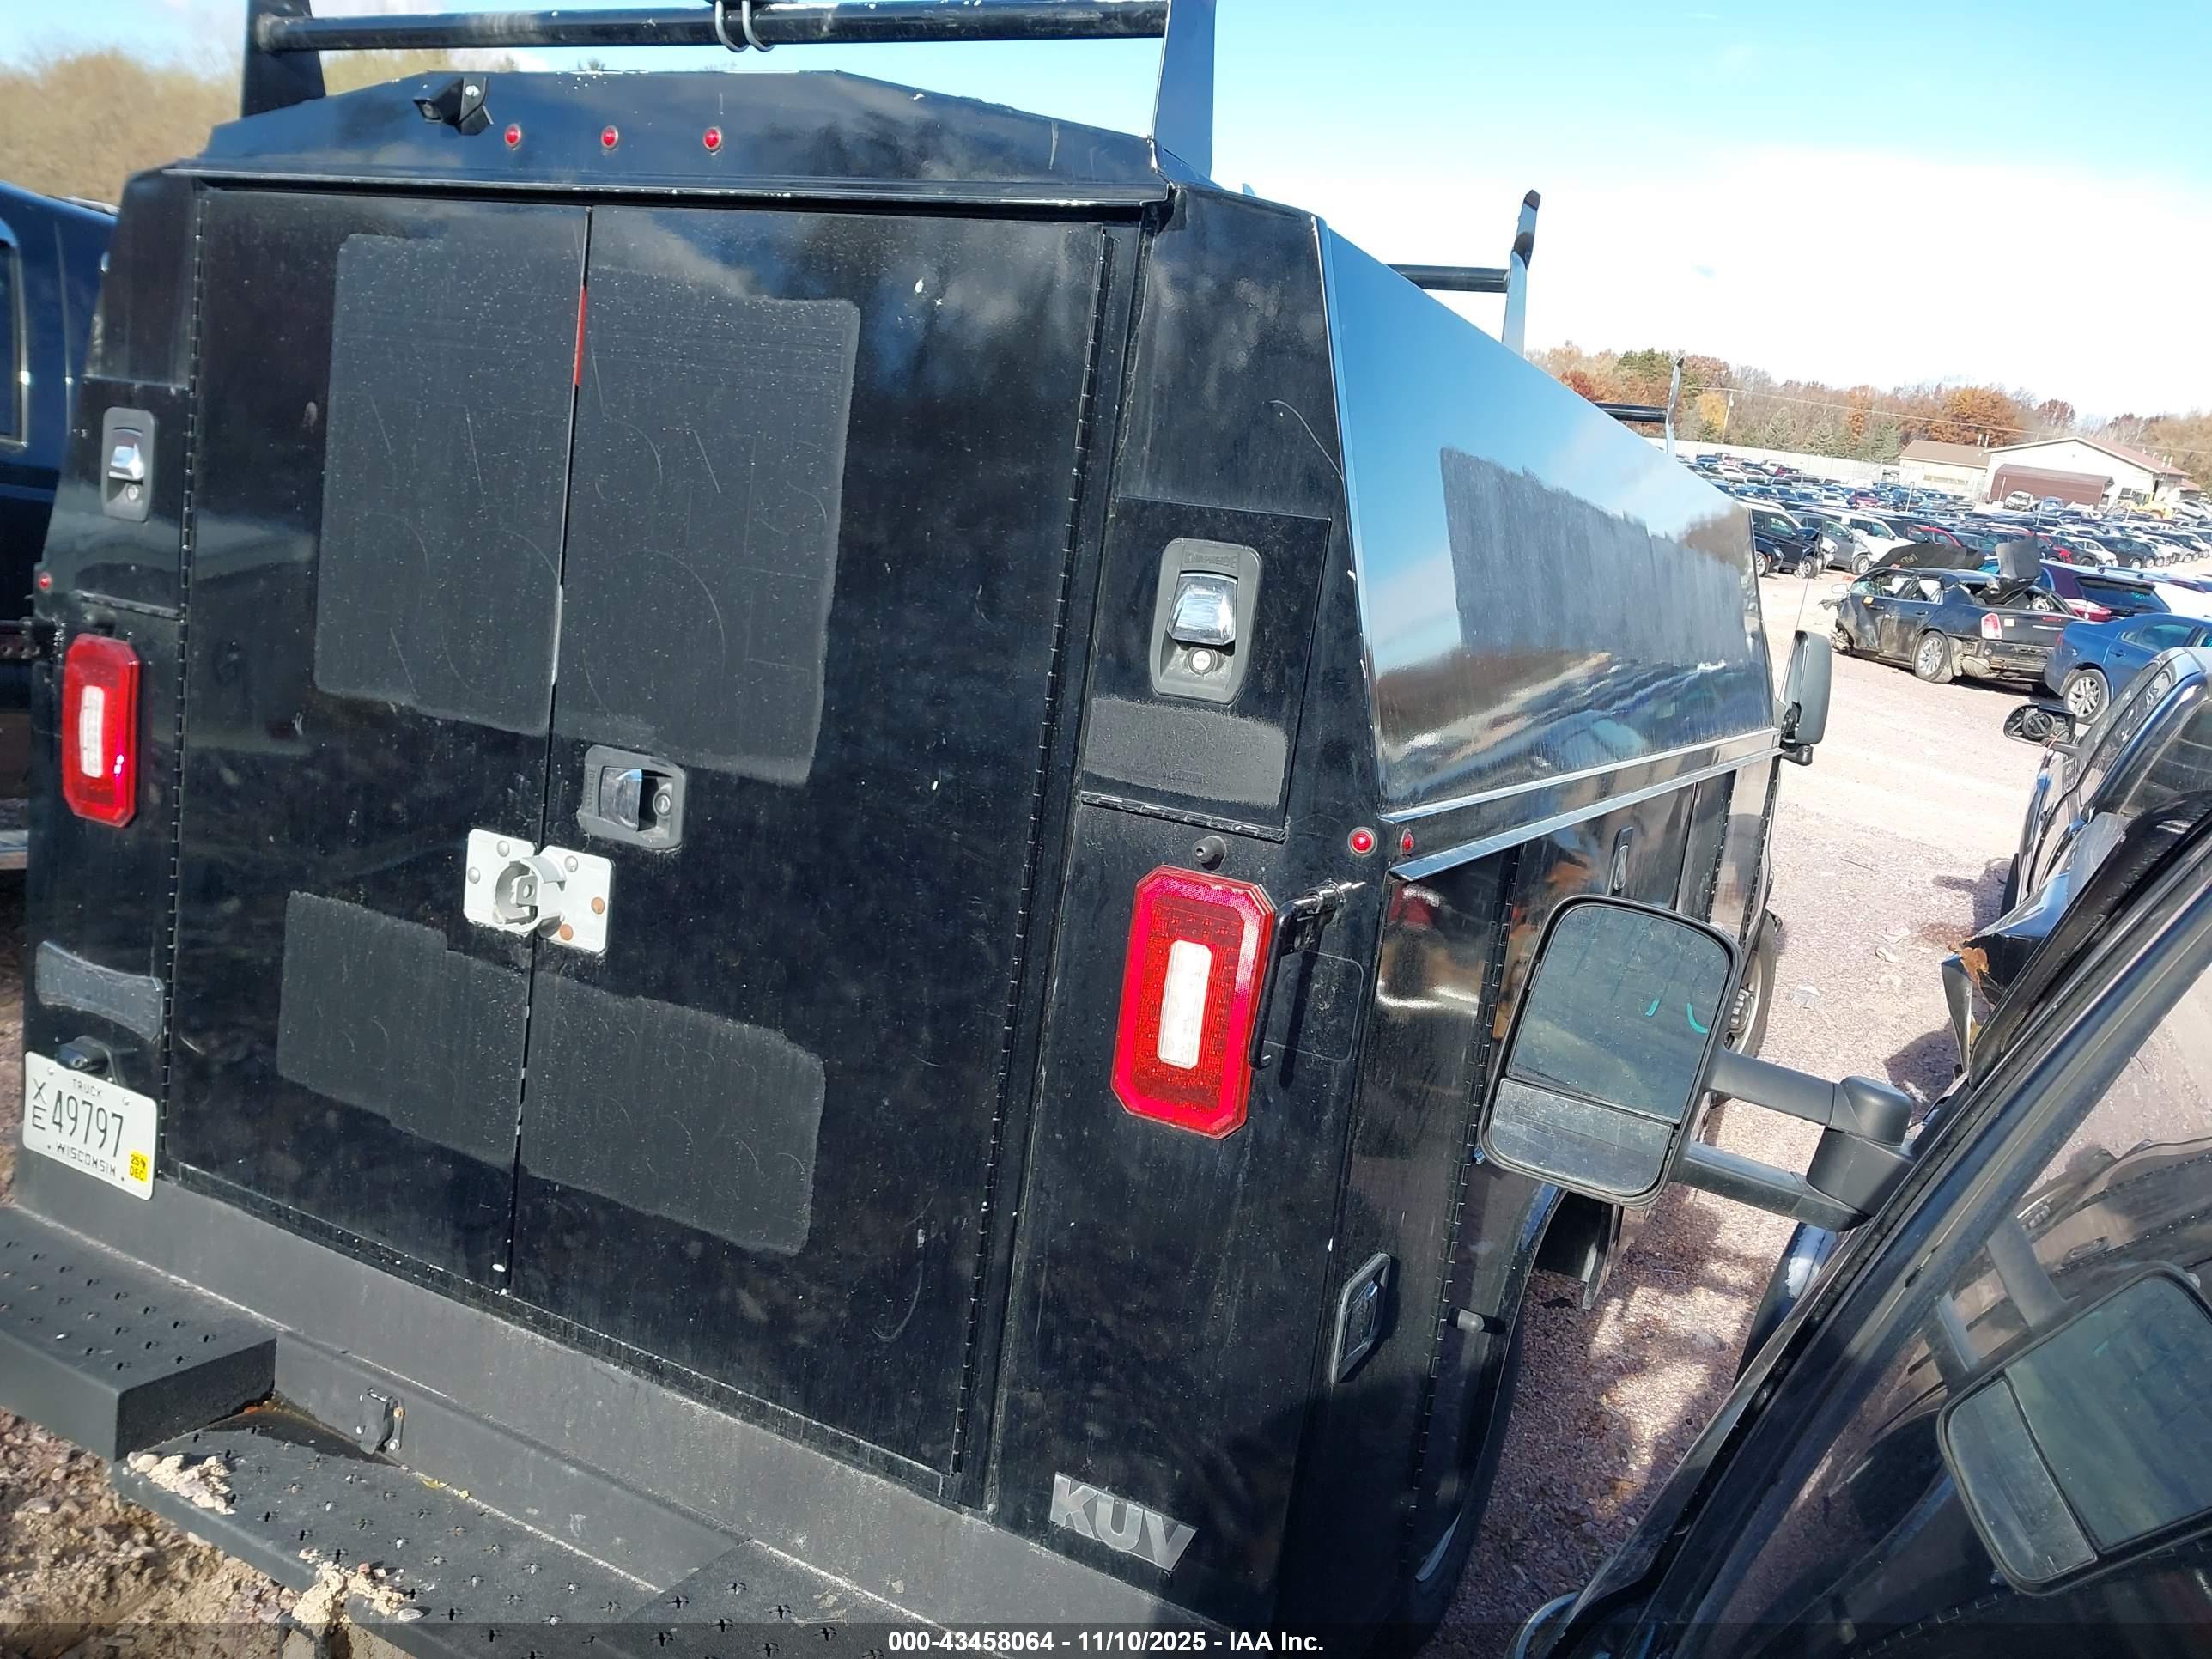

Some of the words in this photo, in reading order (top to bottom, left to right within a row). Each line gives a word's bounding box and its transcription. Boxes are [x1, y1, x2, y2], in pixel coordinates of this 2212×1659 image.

[72, 1079, 102, 1097] TRUCK
[52, 1090, 123, 1158] 49797
[57, 1142, 117, 1176] WISCONSIN
[1049, 1471, 1198, 1571] KUV
